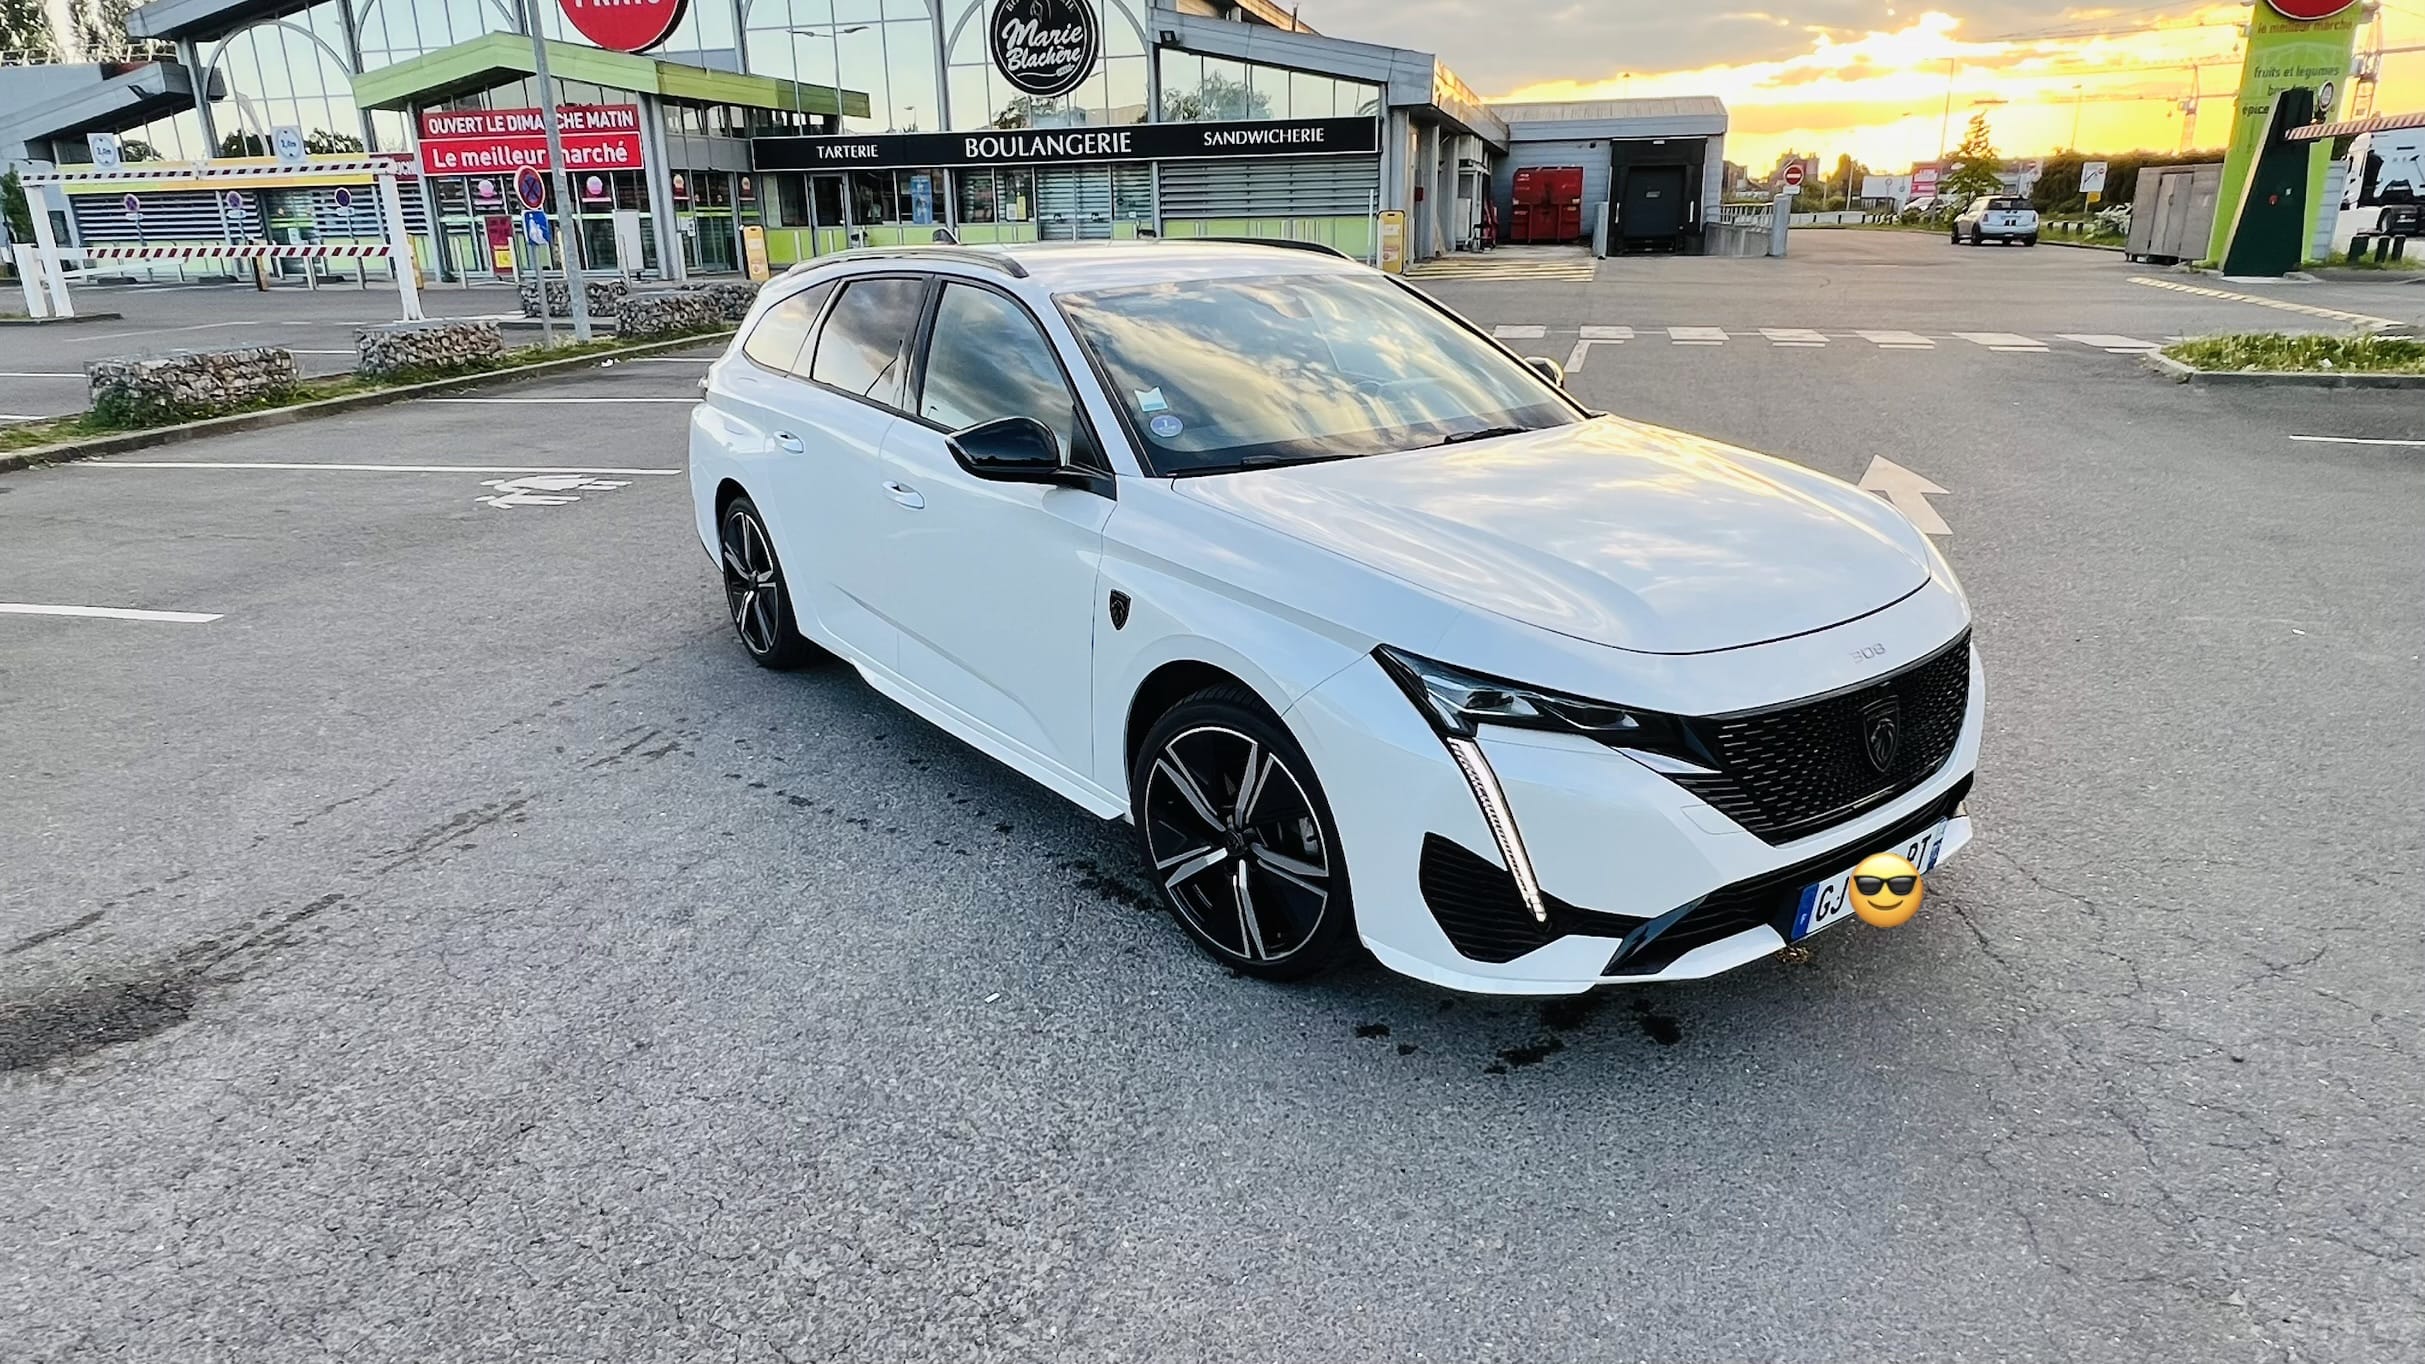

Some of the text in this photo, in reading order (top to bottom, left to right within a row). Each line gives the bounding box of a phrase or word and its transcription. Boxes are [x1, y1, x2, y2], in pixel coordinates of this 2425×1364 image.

[1001, 17, 1084, 50] Marie
[1006, 45, 1081, 71] Blachère
[2254, 66, 2281, 78] fruits
[428, 109, 634, 135] OUVERT LE DIMACHE MATIN
[965, 132, 1132, 158] BOULANGERIE
[1203, 127, 1325, 146] SANDWICHERIE
[432, 148, 457, 168] Le
[461, 145, 547, 167] meilleur
[816, 144, 879, 159] TARTERIE
[1815, 876, 1850, 922] GJ
